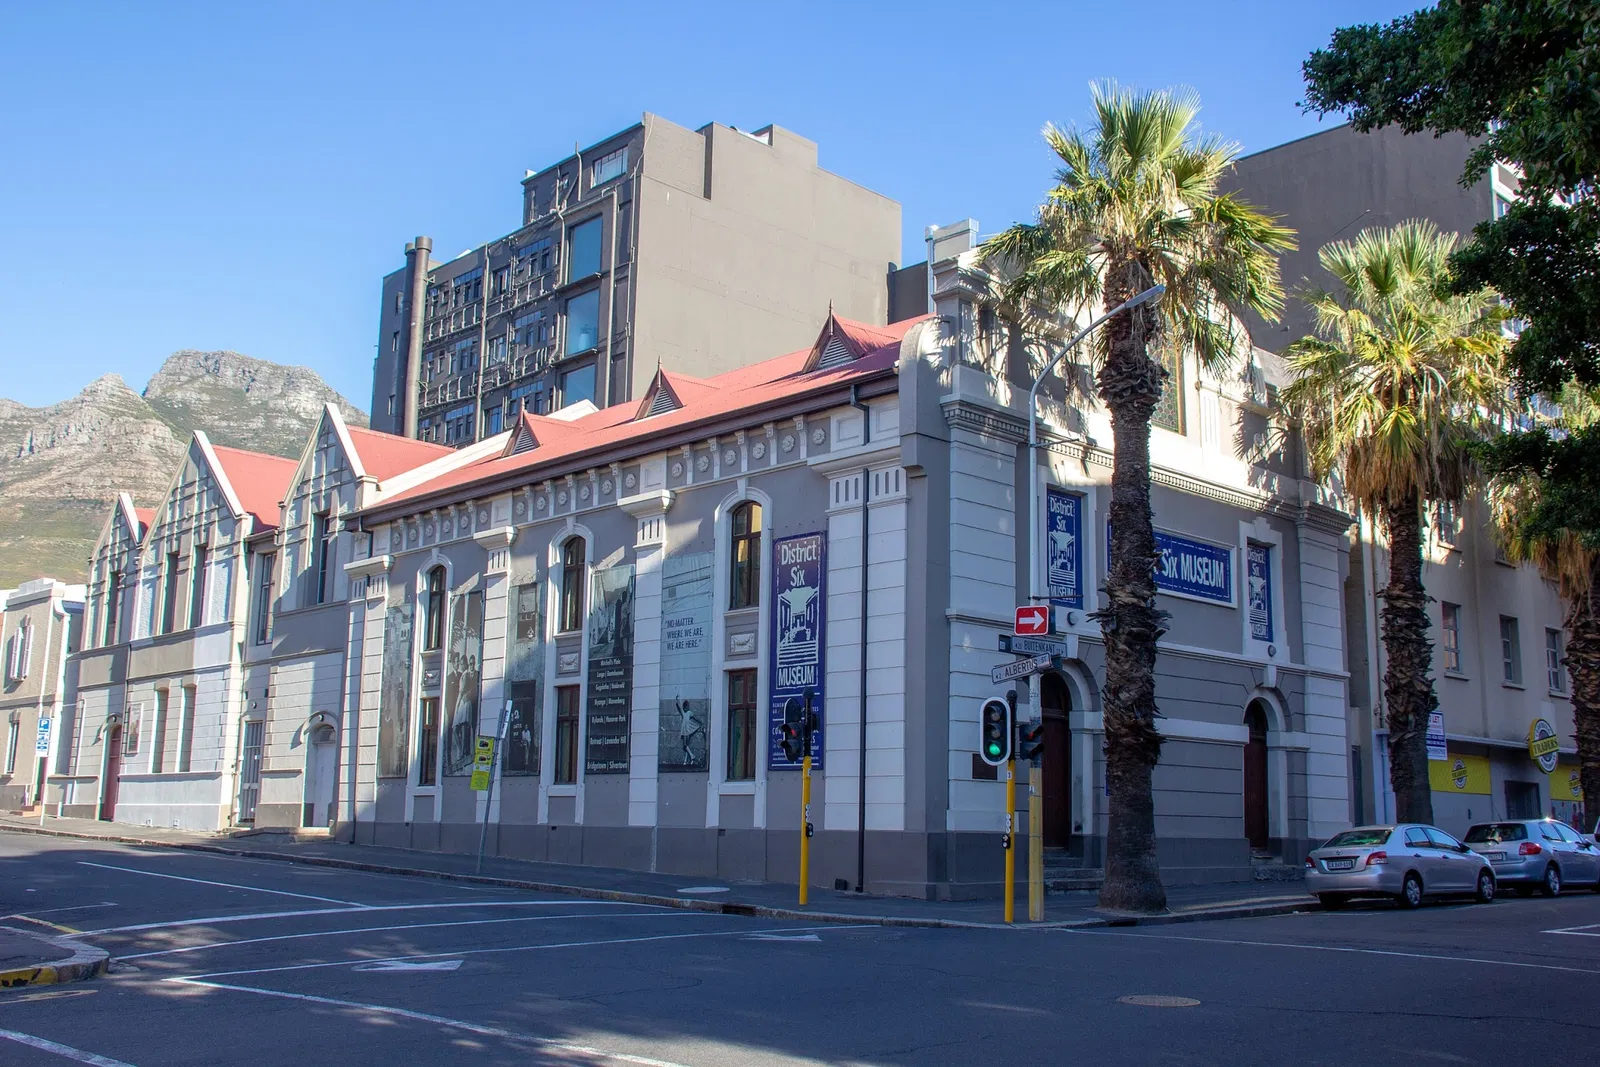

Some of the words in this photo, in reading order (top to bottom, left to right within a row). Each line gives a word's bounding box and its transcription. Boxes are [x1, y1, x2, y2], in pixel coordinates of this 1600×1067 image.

[1050, 497, 1074, 516] District
[1056, 516, 1066, 531] Six
[781, 541, 817, 566] District
[790, 565, 805, 586] Six
[1161, 548, 1178, 578] Six
[1181, 552, 1225, 588] MUSEUM
[675, 617, 694, 627] MATTER
[666, 630, 683, 639] WHERE
[684, 628, 692, 637] WE
[666, 642, 674, 650] WE
[675, 640, 684, 649] ARE
[1023, 640, 1055, 655] BUITENKANT
[778, 666, 814, 686] MUSEUM
[1004, 659, 1038, 678] ALBERTUS
